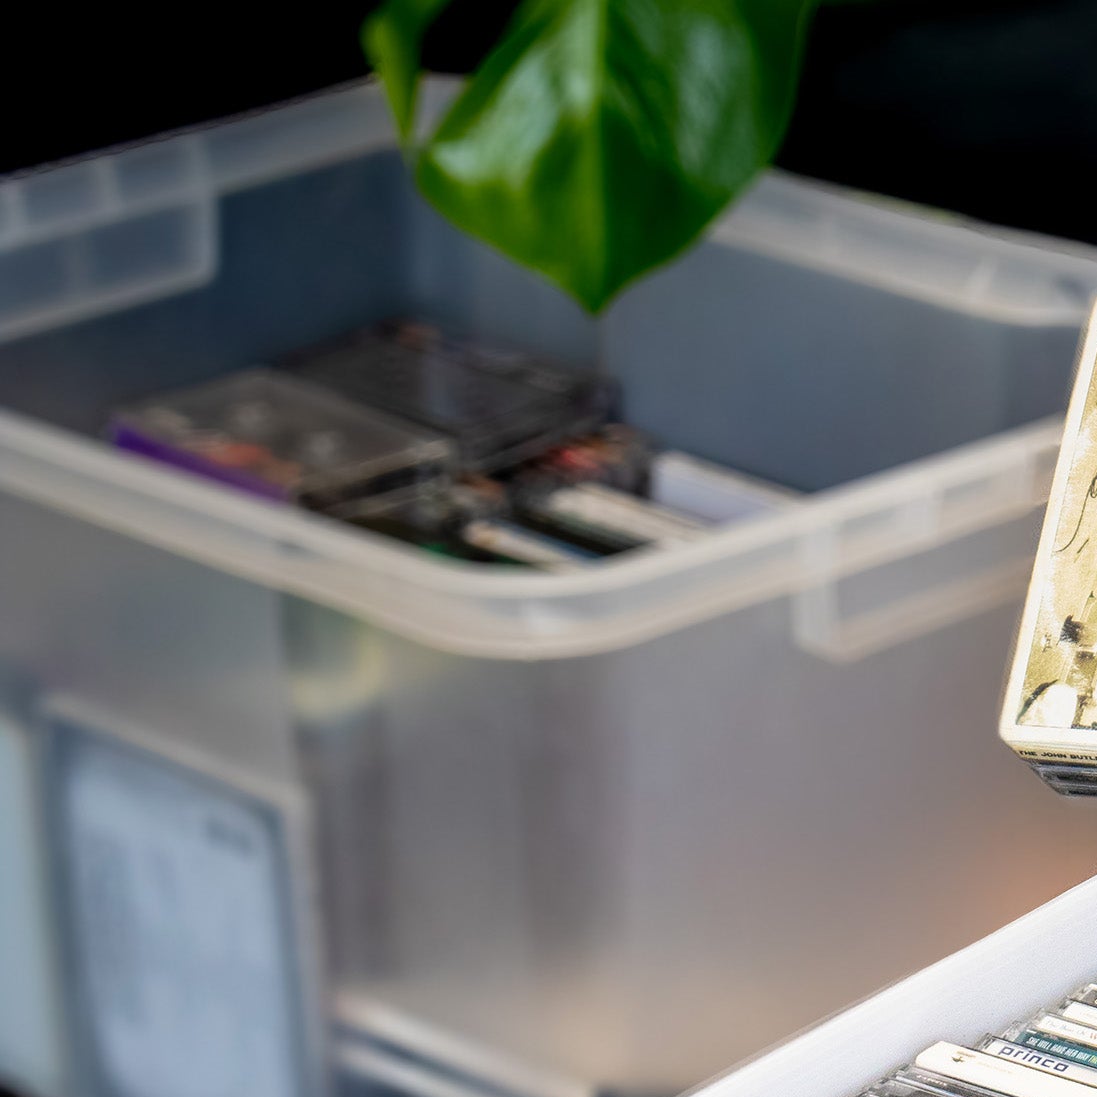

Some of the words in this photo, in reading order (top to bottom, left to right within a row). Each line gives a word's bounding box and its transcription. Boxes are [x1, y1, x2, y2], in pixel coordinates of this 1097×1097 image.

[1018, 749, 1038, 757] THE
[1041, 751, 1067, 759] JOHN
[998, 1046, 1069, 1073] princo
